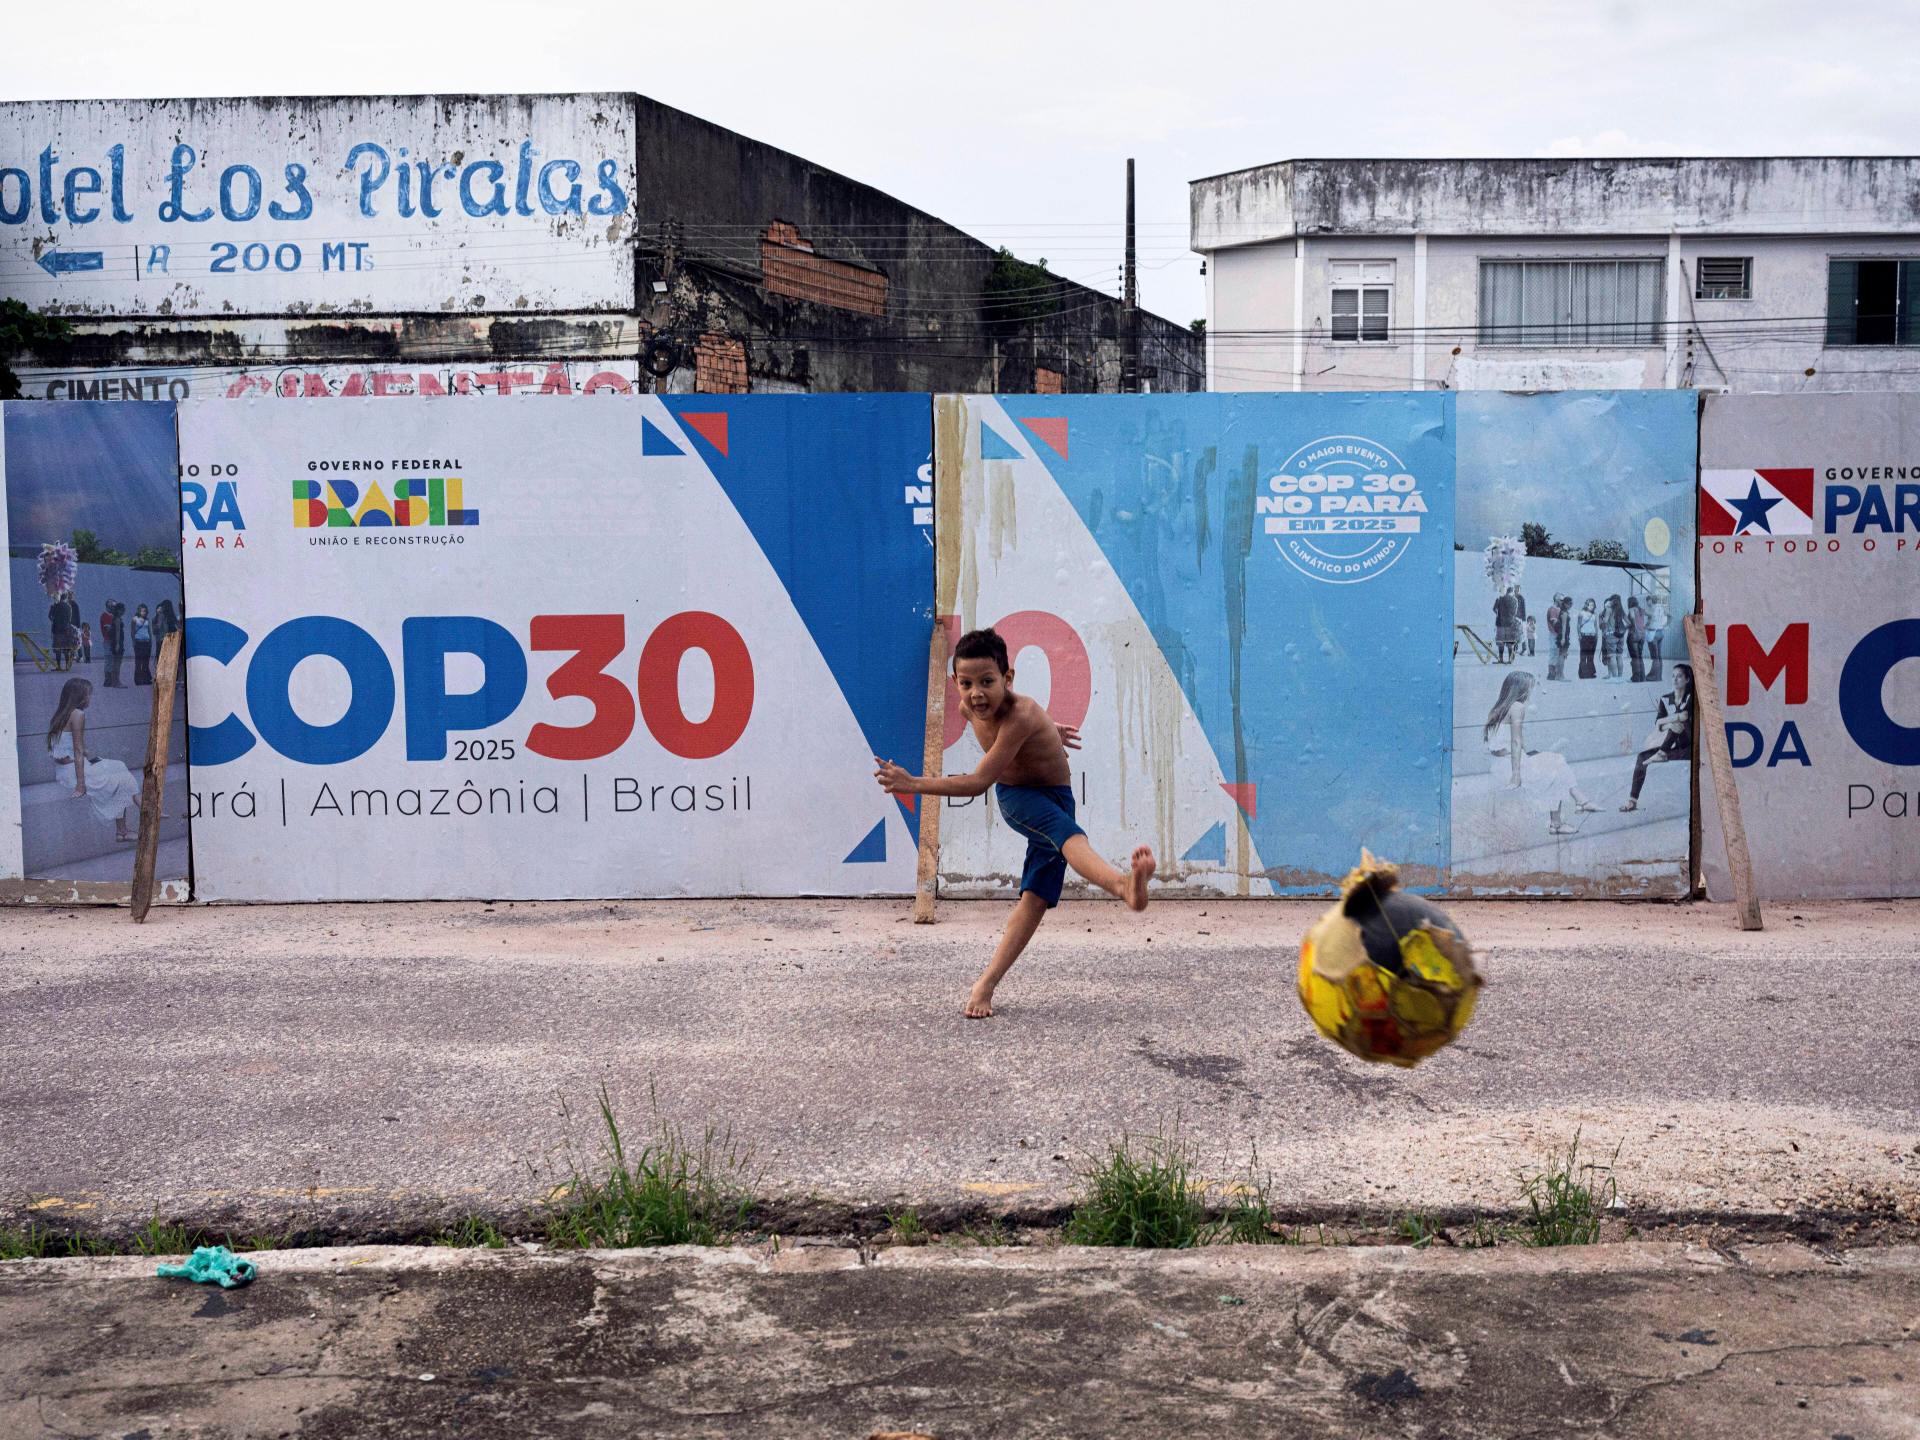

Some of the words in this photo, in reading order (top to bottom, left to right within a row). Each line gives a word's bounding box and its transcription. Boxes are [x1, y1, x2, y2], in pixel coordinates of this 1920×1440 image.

[0, 142, 133, 224] otel
[159, 143, 313, 222] Los
[345, 138, 628, 218] Piratas
[210, 242, 302, 273] 200
[47, 376, 189, 400] CIMENTO
[308, 460, 384, 471] GOVERNO
[392, 459, 462, 470] FEDERAL
[1298, 460, 1307, 469] O
[1307, 445, 1344, 463] MAIOR
[1346, 445, 1388, 468] EVENTO
[211, 464, 238, 477] DO
[1825, 466, 1920, 480] GOVERNO
[1269, 475, 1354, 493] COP
[1362, 474, 1416, 492] 30
[292, 478, 480, 528] BRASIL
[1256, 496, 1312, 514] NO
[1320, 490, 1428, 513] PARÁ
[1289, 520, 1325, 530] EM
[1332, 519, 1396, 530] 2025
[310, 535, 348, 546] UNIÃO
[354, 536, 360, 545] E
[365, 534, 465, 546] RECONSTRUÇÃO
[1765, 540, 1840, 553] TODO
[1863, 539, 1876, 552] O
[1289, 540, 1342, 573] CLIMÁTICO
[1344, 563, 1360, 573] DO
[1362, 540, 1396, 569] MUNDO
[454, 740, 515, 761] 2025
[310, 779, 558, 817] Amazônia
[614, 776, 751, 812] Brasil
